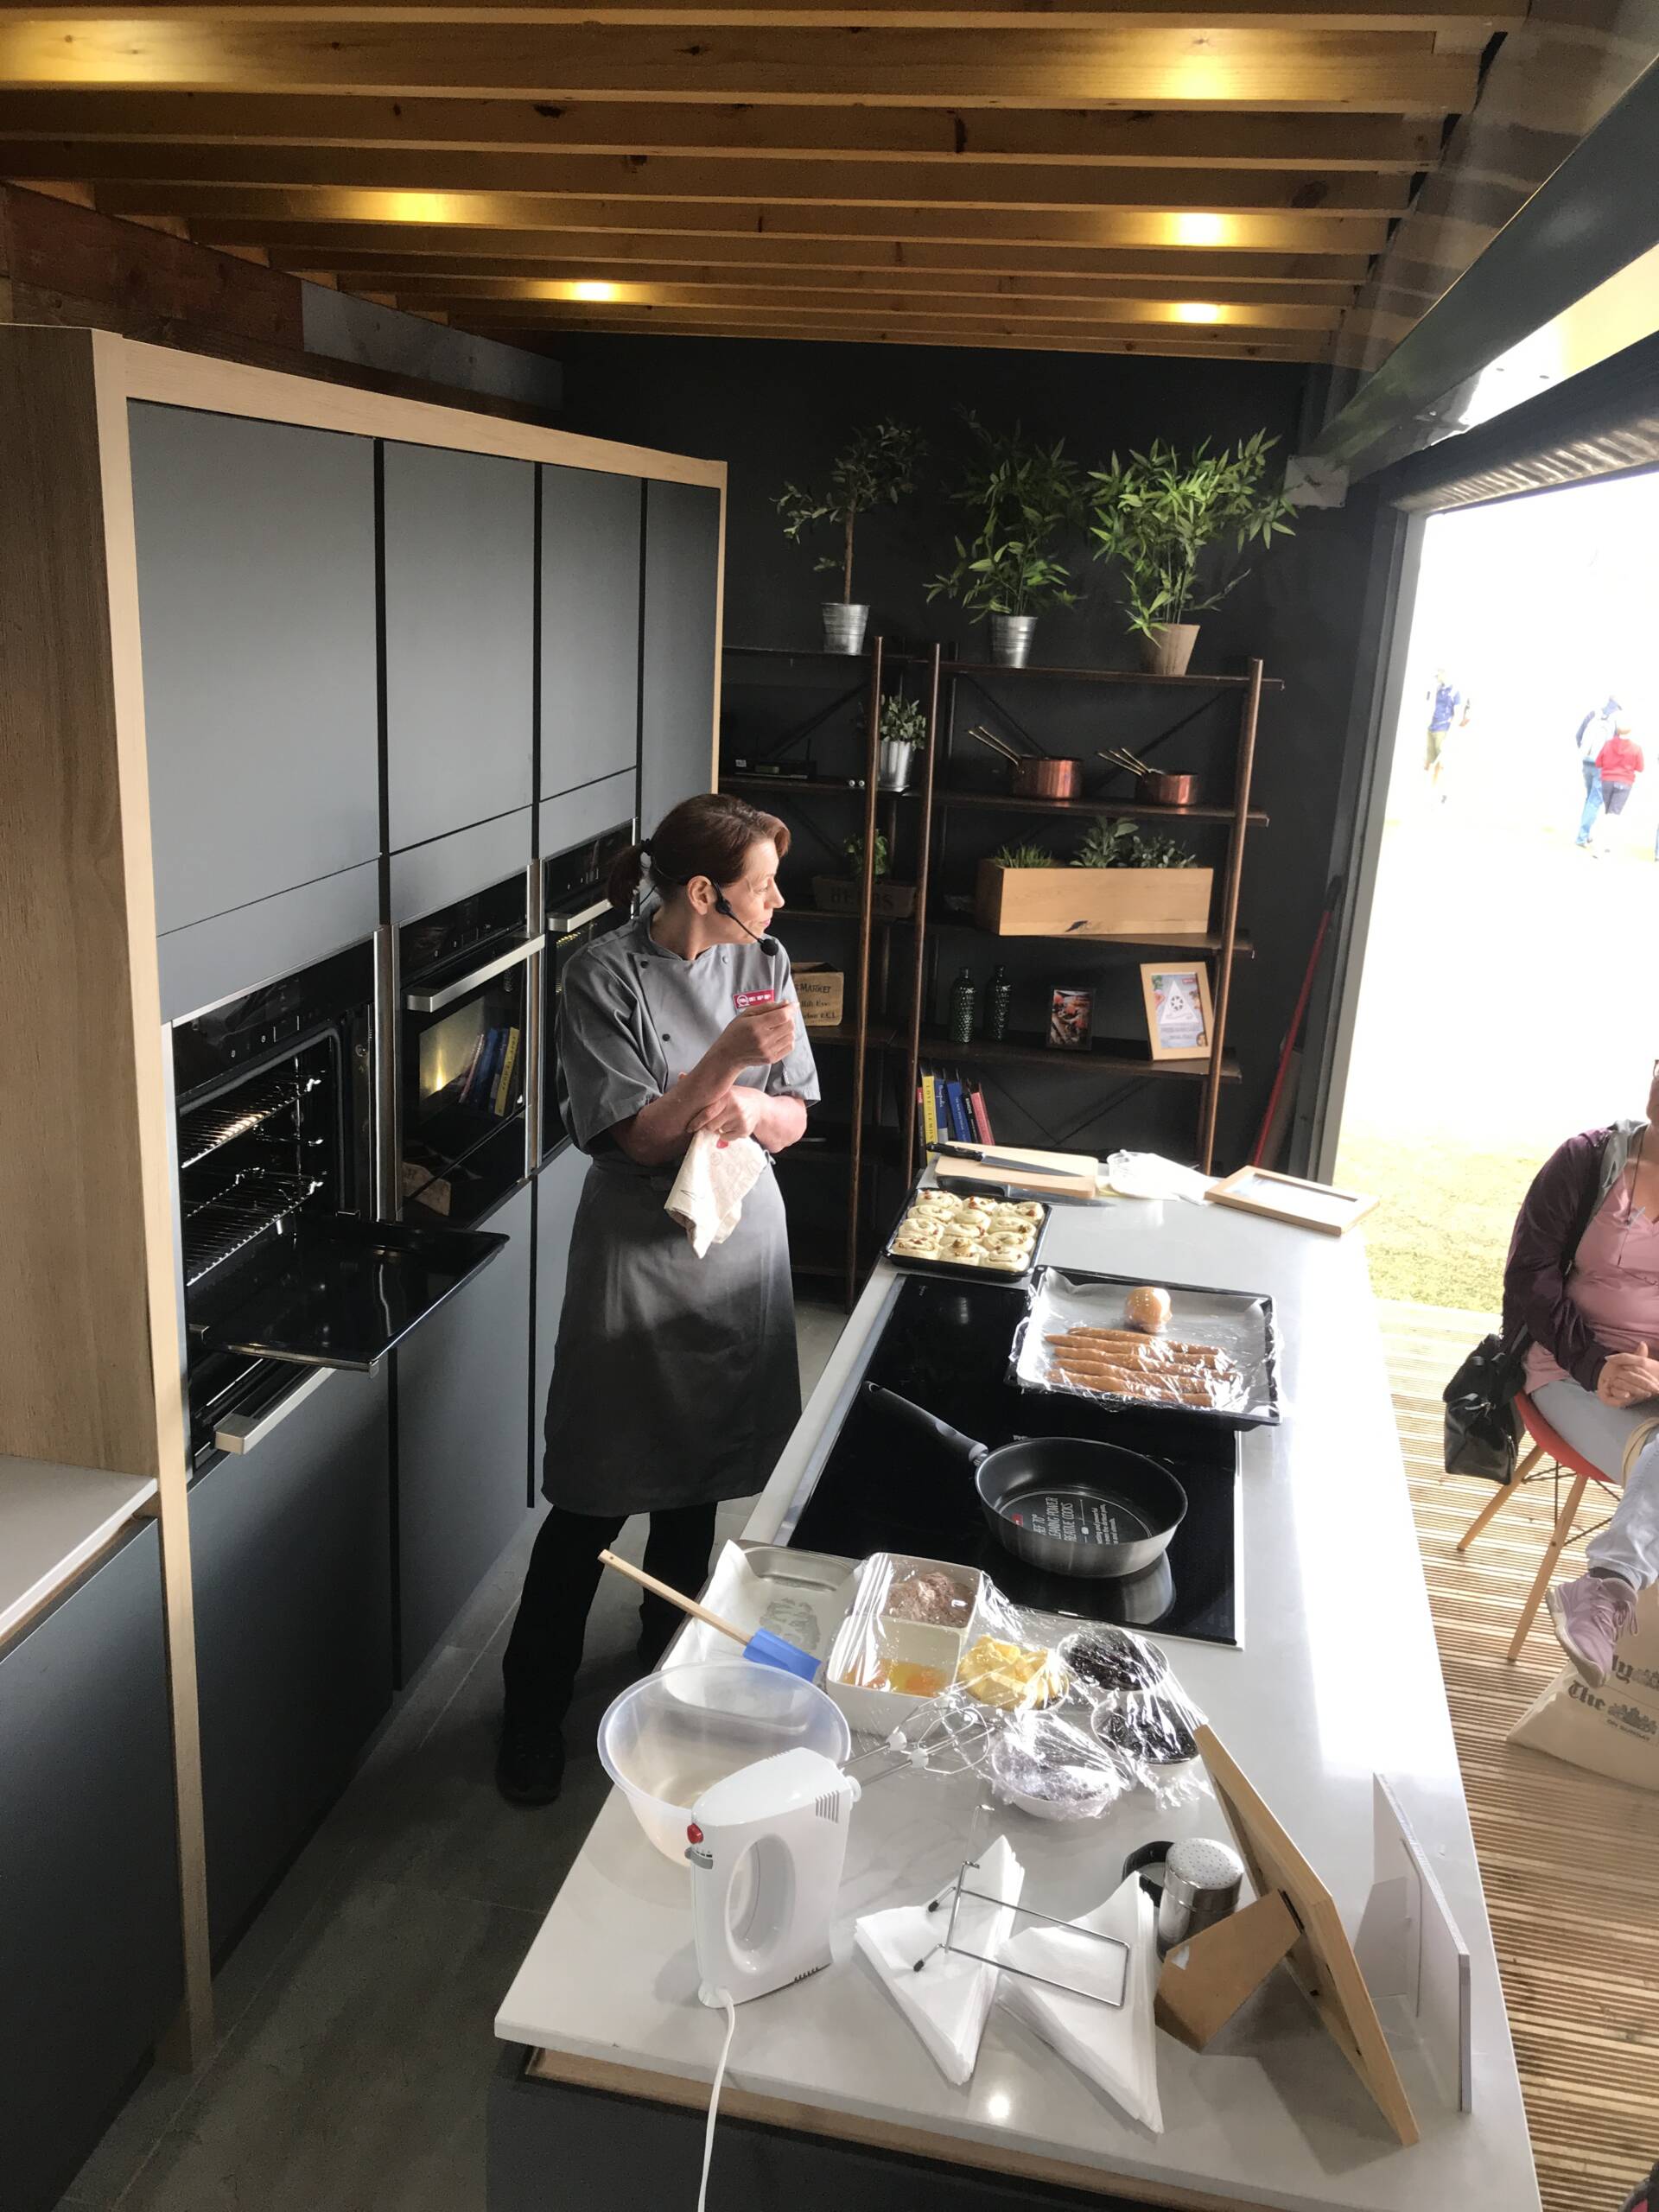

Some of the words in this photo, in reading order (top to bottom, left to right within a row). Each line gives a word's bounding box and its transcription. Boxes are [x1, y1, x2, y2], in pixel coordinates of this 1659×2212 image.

[1046, 1497, 1059, 1516] POWER
[1061, 1503, 1075, 1520] COOKS
[1047, 1516, 1061, 1539] LEANING
[1062, 1521, 1077, 1541] REATIVE
[1568, 1679, 1605, 1711] The
